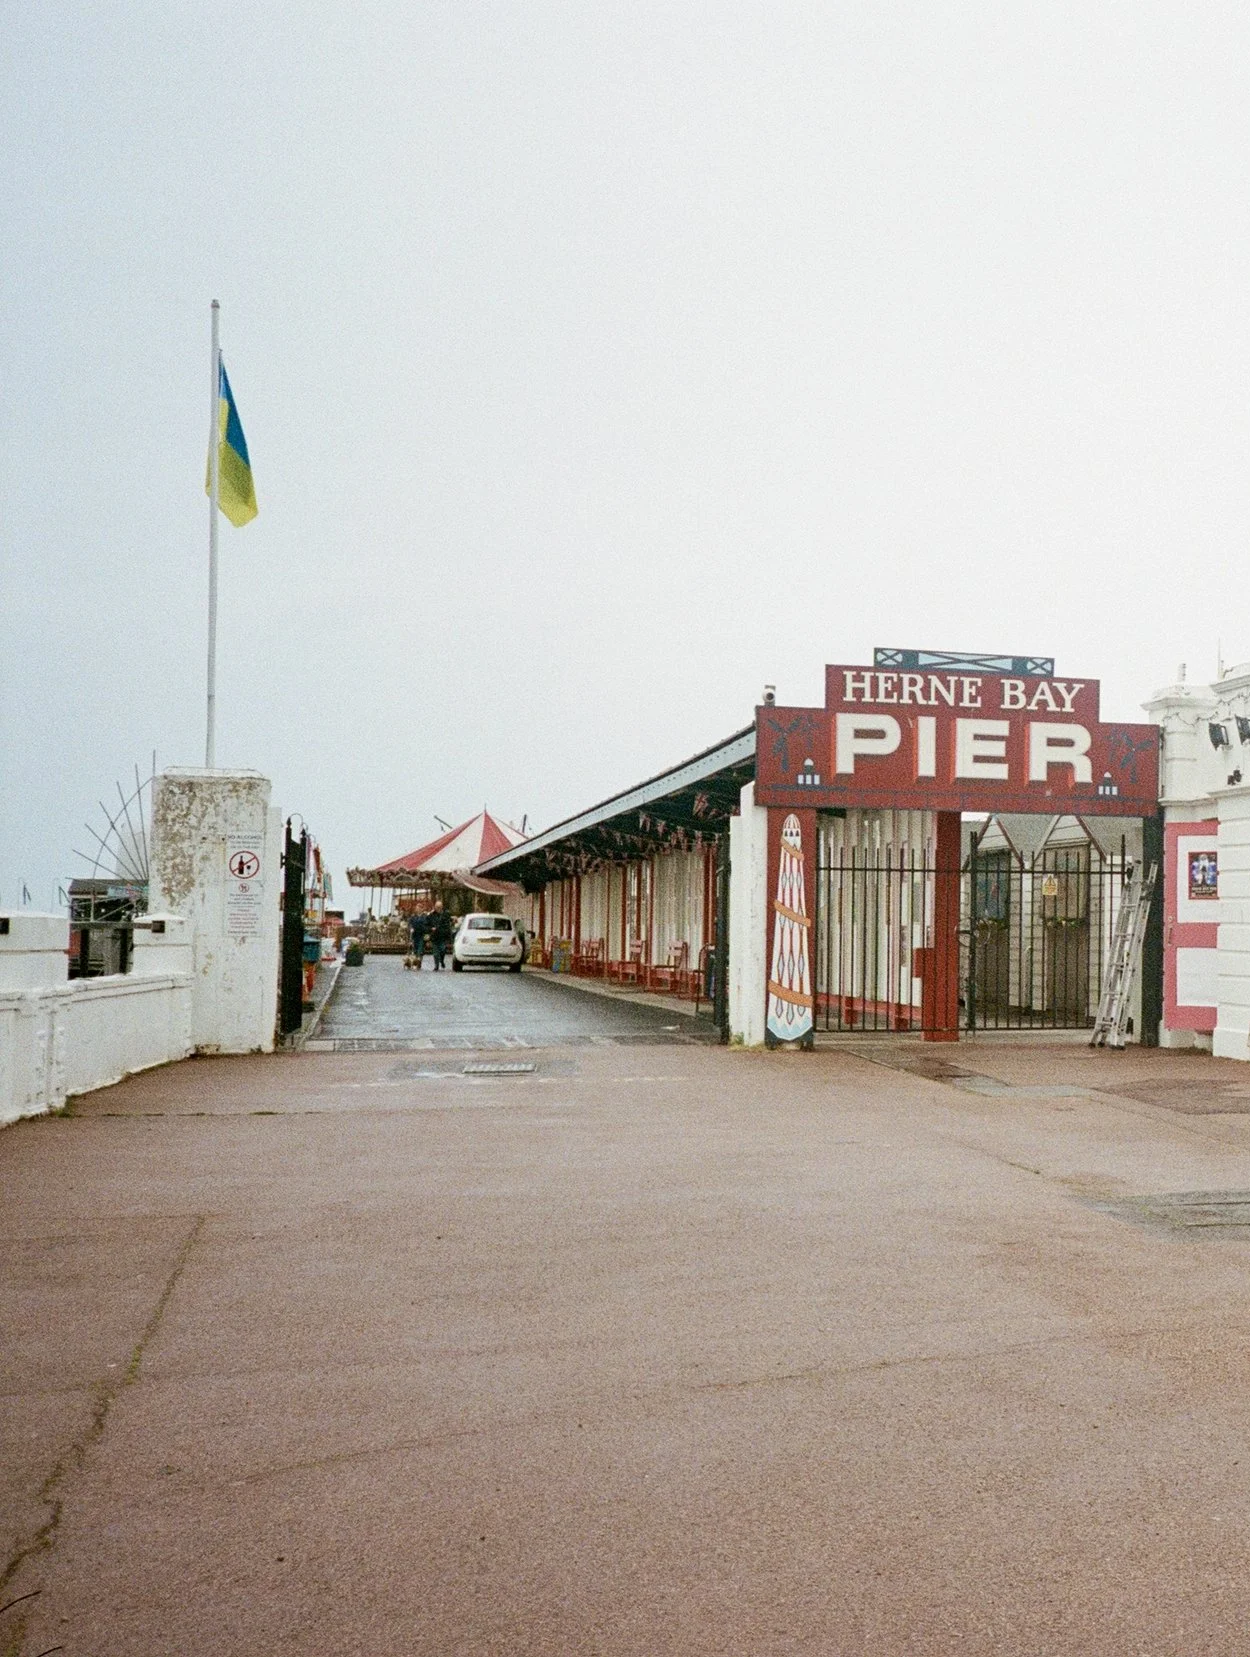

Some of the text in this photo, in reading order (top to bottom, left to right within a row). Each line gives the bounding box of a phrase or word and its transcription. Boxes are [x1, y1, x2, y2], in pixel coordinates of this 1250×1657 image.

[843, 671, 1084, 713] HERNE BAY
[835, 713, 1093, 784] PIER
